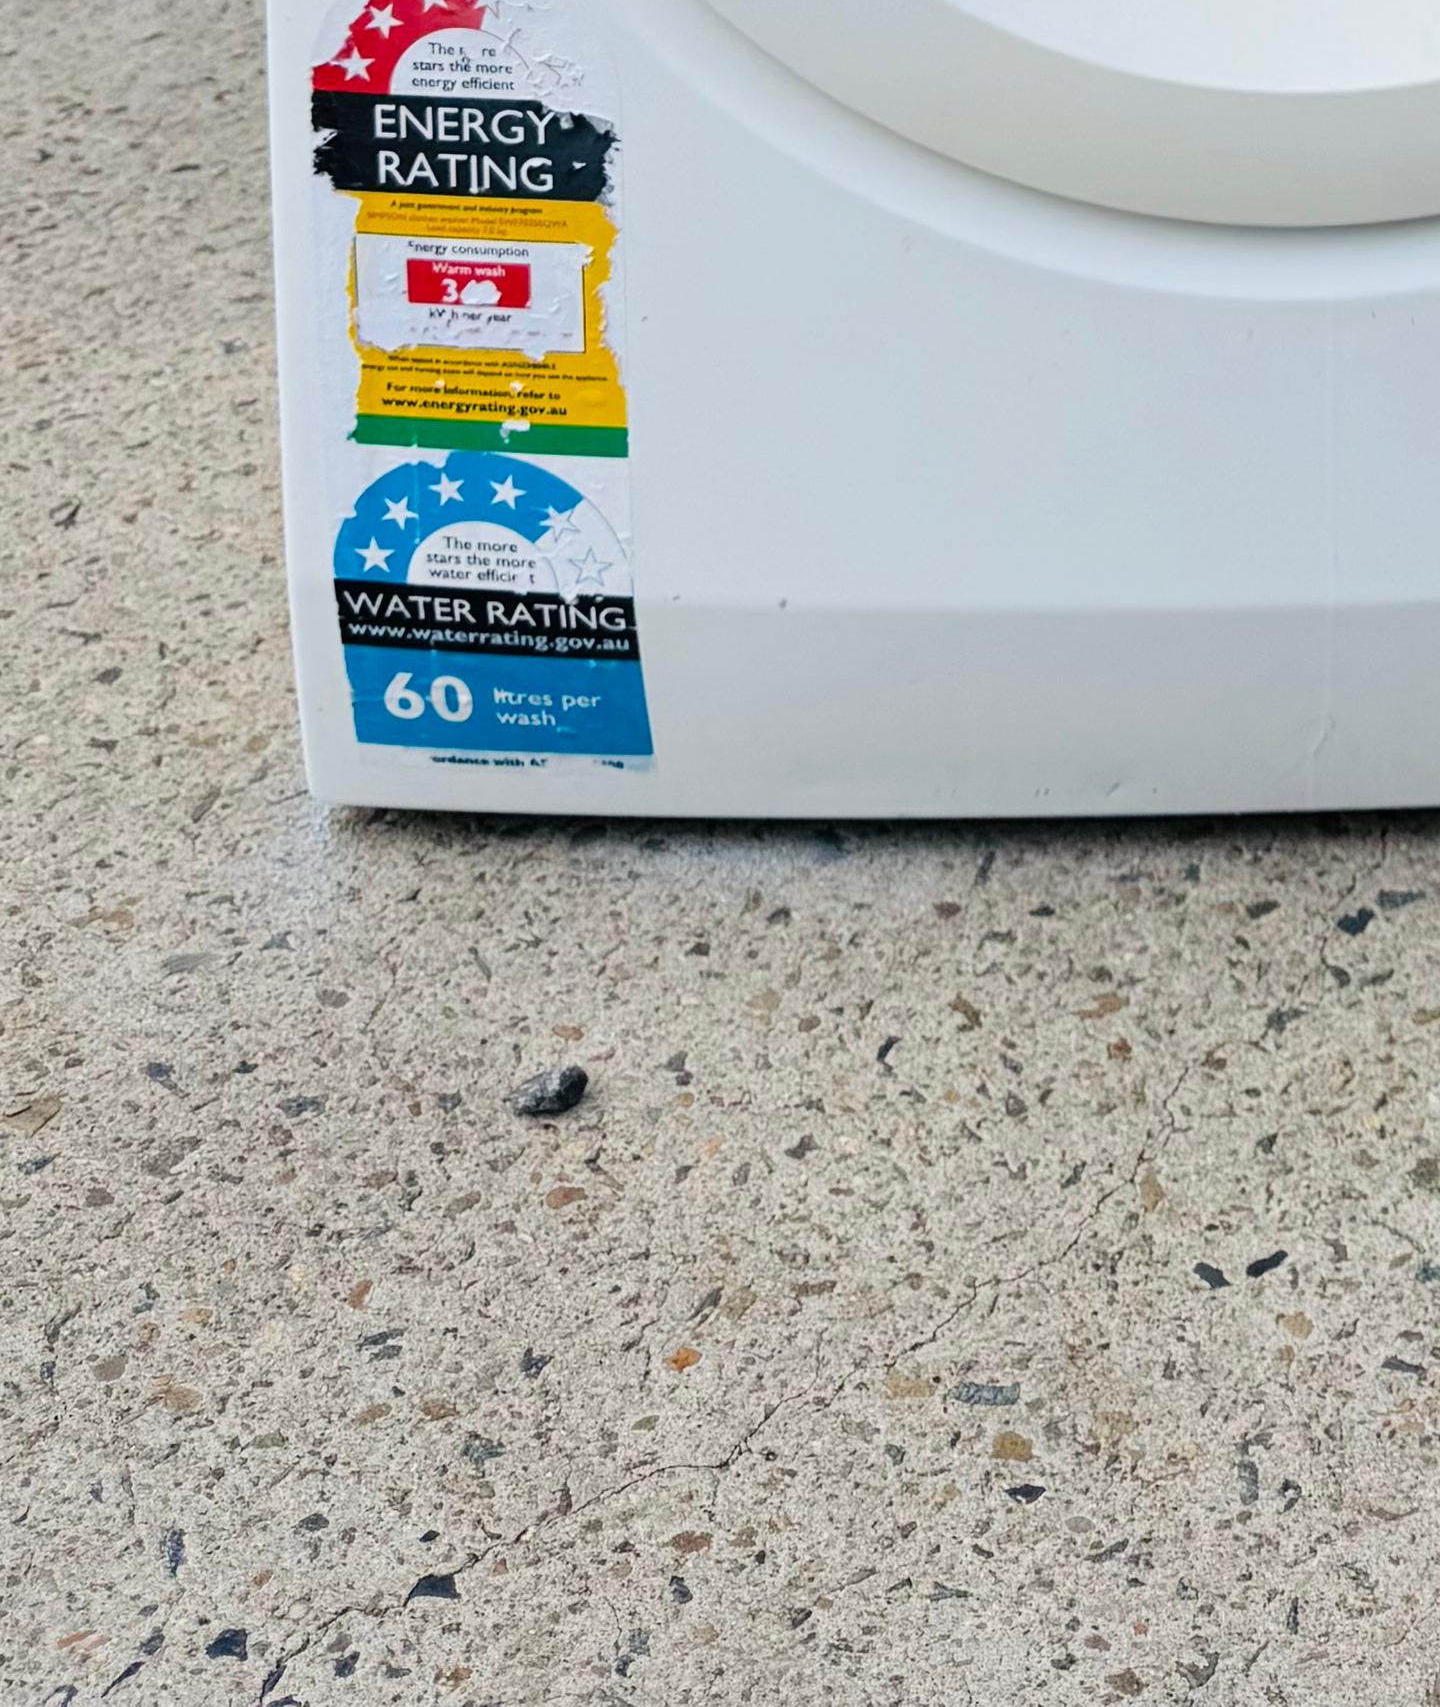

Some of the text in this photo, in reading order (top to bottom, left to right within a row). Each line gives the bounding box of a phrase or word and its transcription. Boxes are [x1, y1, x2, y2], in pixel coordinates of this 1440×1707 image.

[428, 42, 455, 55] The
[412, 59, 513, 74] stars the more
[411, 77, 515, 91] energy efficient
[374, 104, 555, 145] ENERGY
[377, 150, 553, 192] RATING
[451, 245, 529, 258] consumption
[432, 262, 506, 277] Warm wash
[382, 398, 567, 417] www.energyrating.gov.au
[442, 536, 518, 553] The more
[426, 552, 537, 569] stars the more
[428, 568, 472, 581] water
[343, 590, 627, 631] WATER RATING
[348, 621, 630, 652] www.waterrating.gov.au
[383, 671, 473, 723] 60
[561, 695, 602, 712] per
[496, 709, 556, 726] wash
